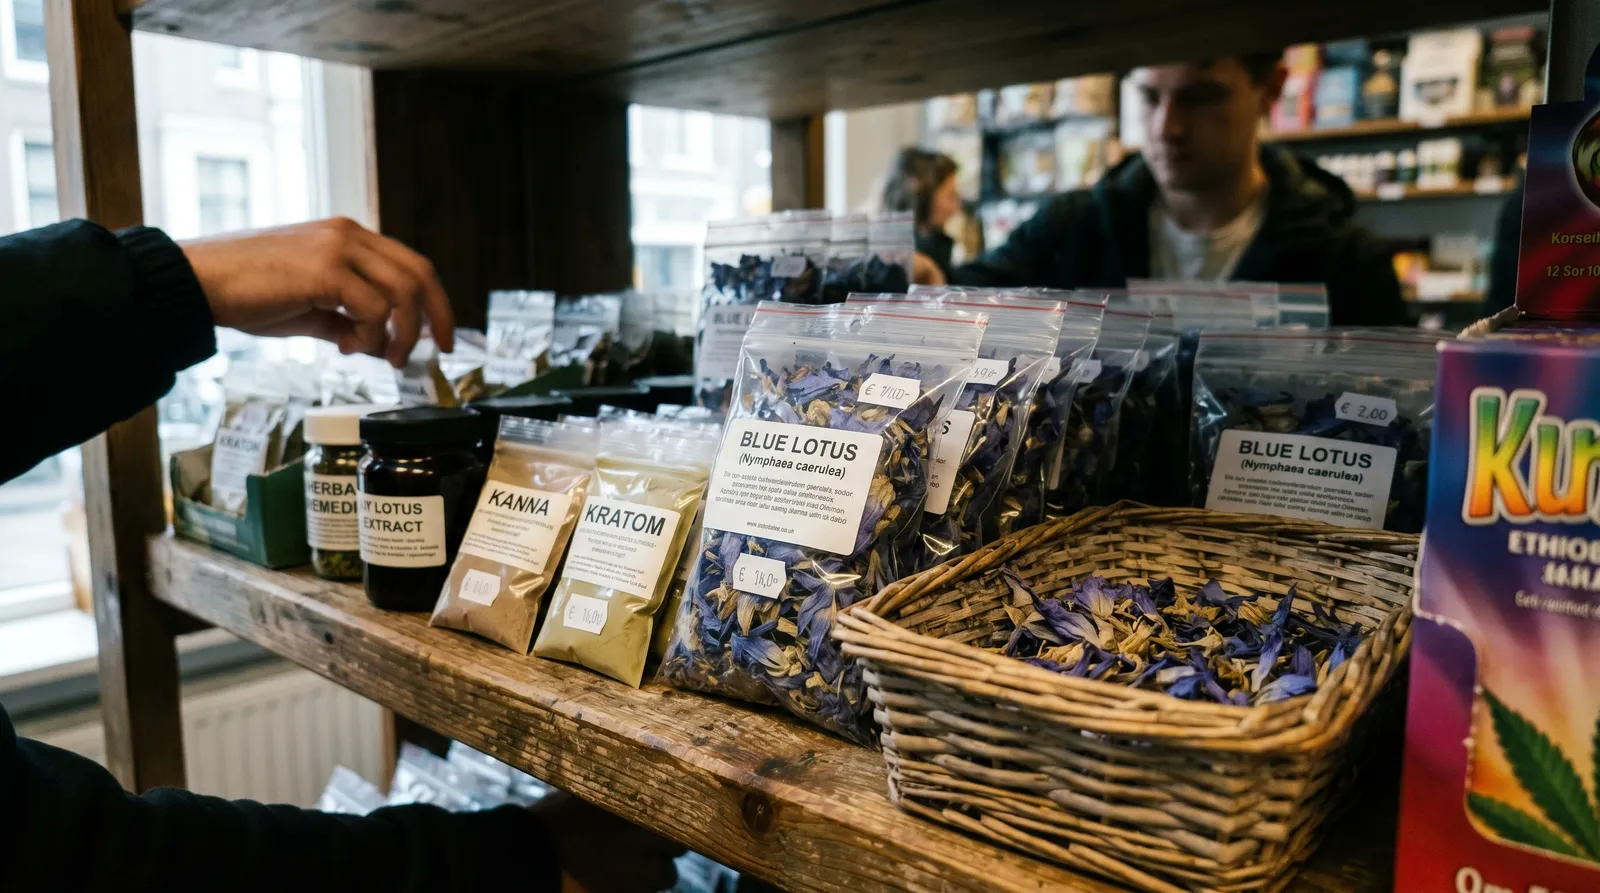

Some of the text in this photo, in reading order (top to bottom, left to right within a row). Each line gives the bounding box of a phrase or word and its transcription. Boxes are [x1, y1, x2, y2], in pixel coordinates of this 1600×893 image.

[1547, 265, 1560, 277] 12
[1564, 265, 1585, 277] Sor
[864, 384, 876, 396] €
[1341, 402, 1388, 421] € 2,00
[740, 430, 858, 461] BLUE LOTUS
[1239, 440, 1373, 469] BLUE LOTUS
[738, 452, 793, 469] (Nymphaea
[795, 462, 846, 481] caerulea)
[1240, 459, 1364, 485] (Nymphaea caerulea)
[375, 502, 423, 515] LOTUS
[488, 489, 550, 516] KANNA
[363, 516, 424, 533] EXTRACT
[585, 504, 666, 537] KRATOM
[739, 566, 746, 582] €
